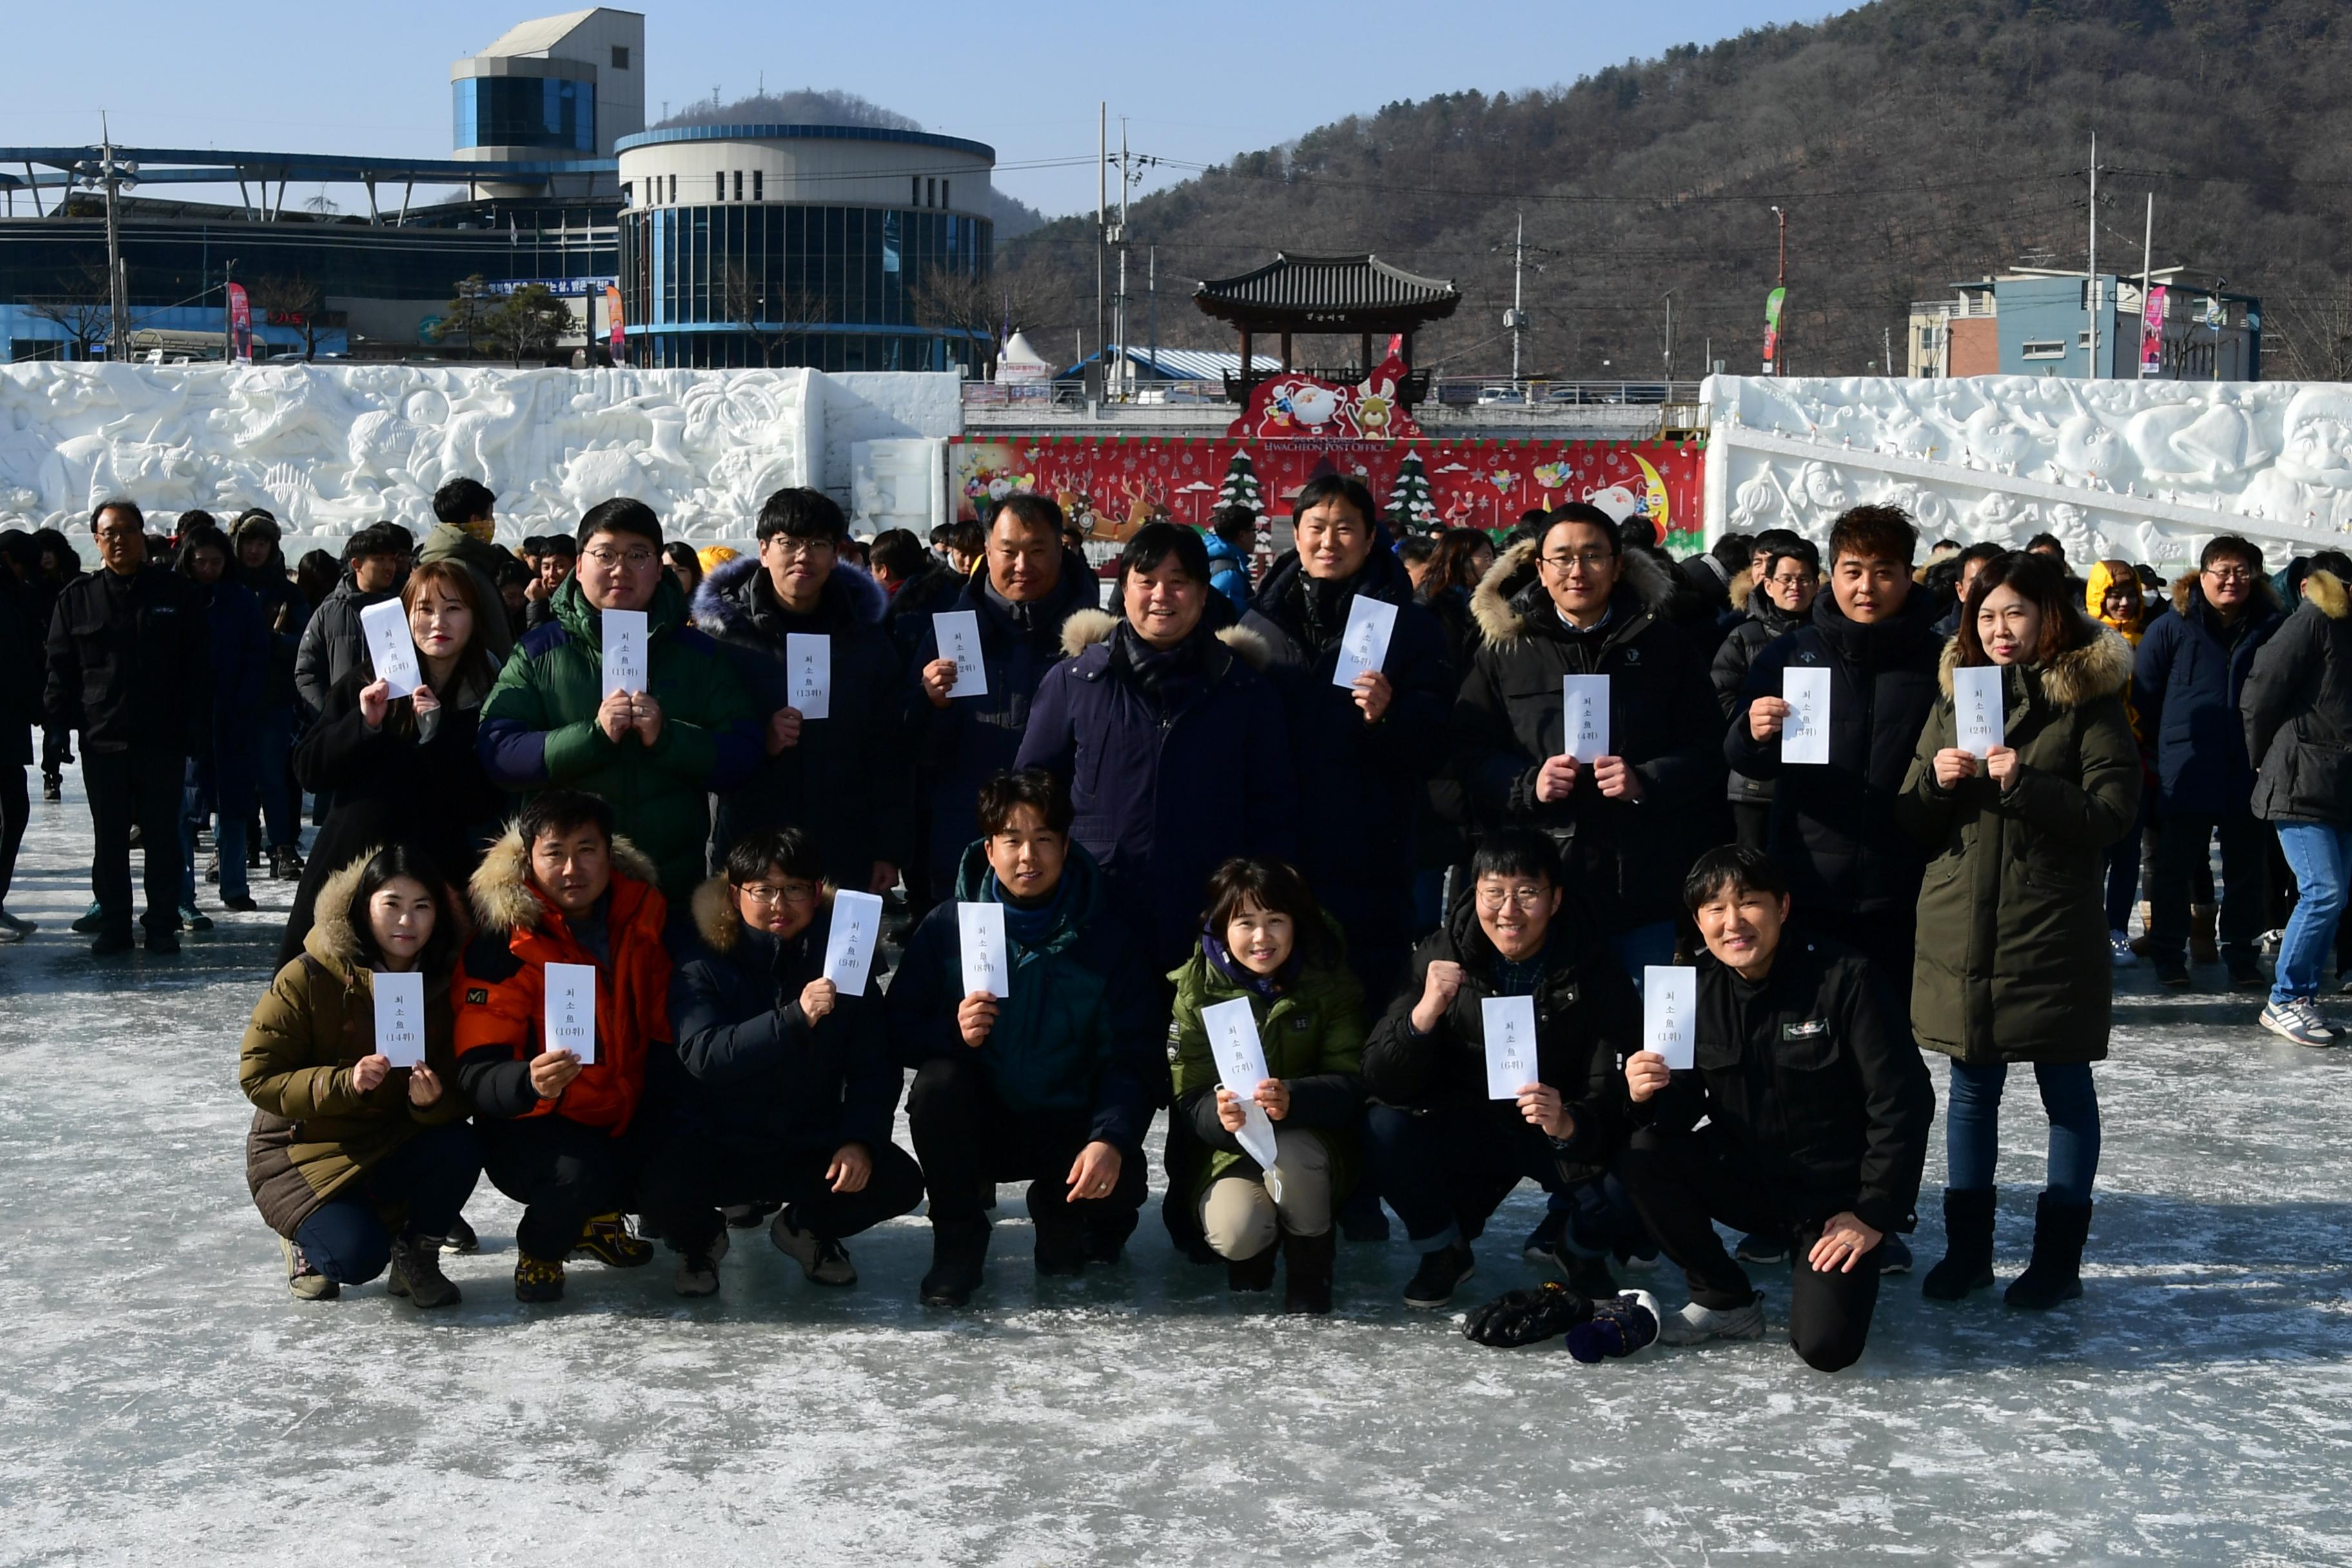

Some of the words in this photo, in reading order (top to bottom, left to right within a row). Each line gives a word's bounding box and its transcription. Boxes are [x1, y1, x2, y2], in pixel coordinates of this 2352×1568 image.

[571, 280, 587, 292] 밝은
[1351, 655, 1371, 667] (5위)
[385, 663, 409, 674] (15위)
[612, 668, 638, 677] (11위)
[797, 689, 821, 698] (13위)
[1795, 727, 1816, 738] (3위)
[1970, 726, 1991, 736] (2위)
[1578, 732, 1598, 741] (4위)
[839, 959, 859, 969] (9위)
[974, 964, 994, 974] (8위)
[556, 1026, 584, 1037] (10위)
[386, 1032, 414, 1043] (14위)
[1658, 1032, 1681, 1043] (1위)
[1232, 1063, 1253, 1073] (7위)
[1501, 1061, 1523, 1070] (6위)
